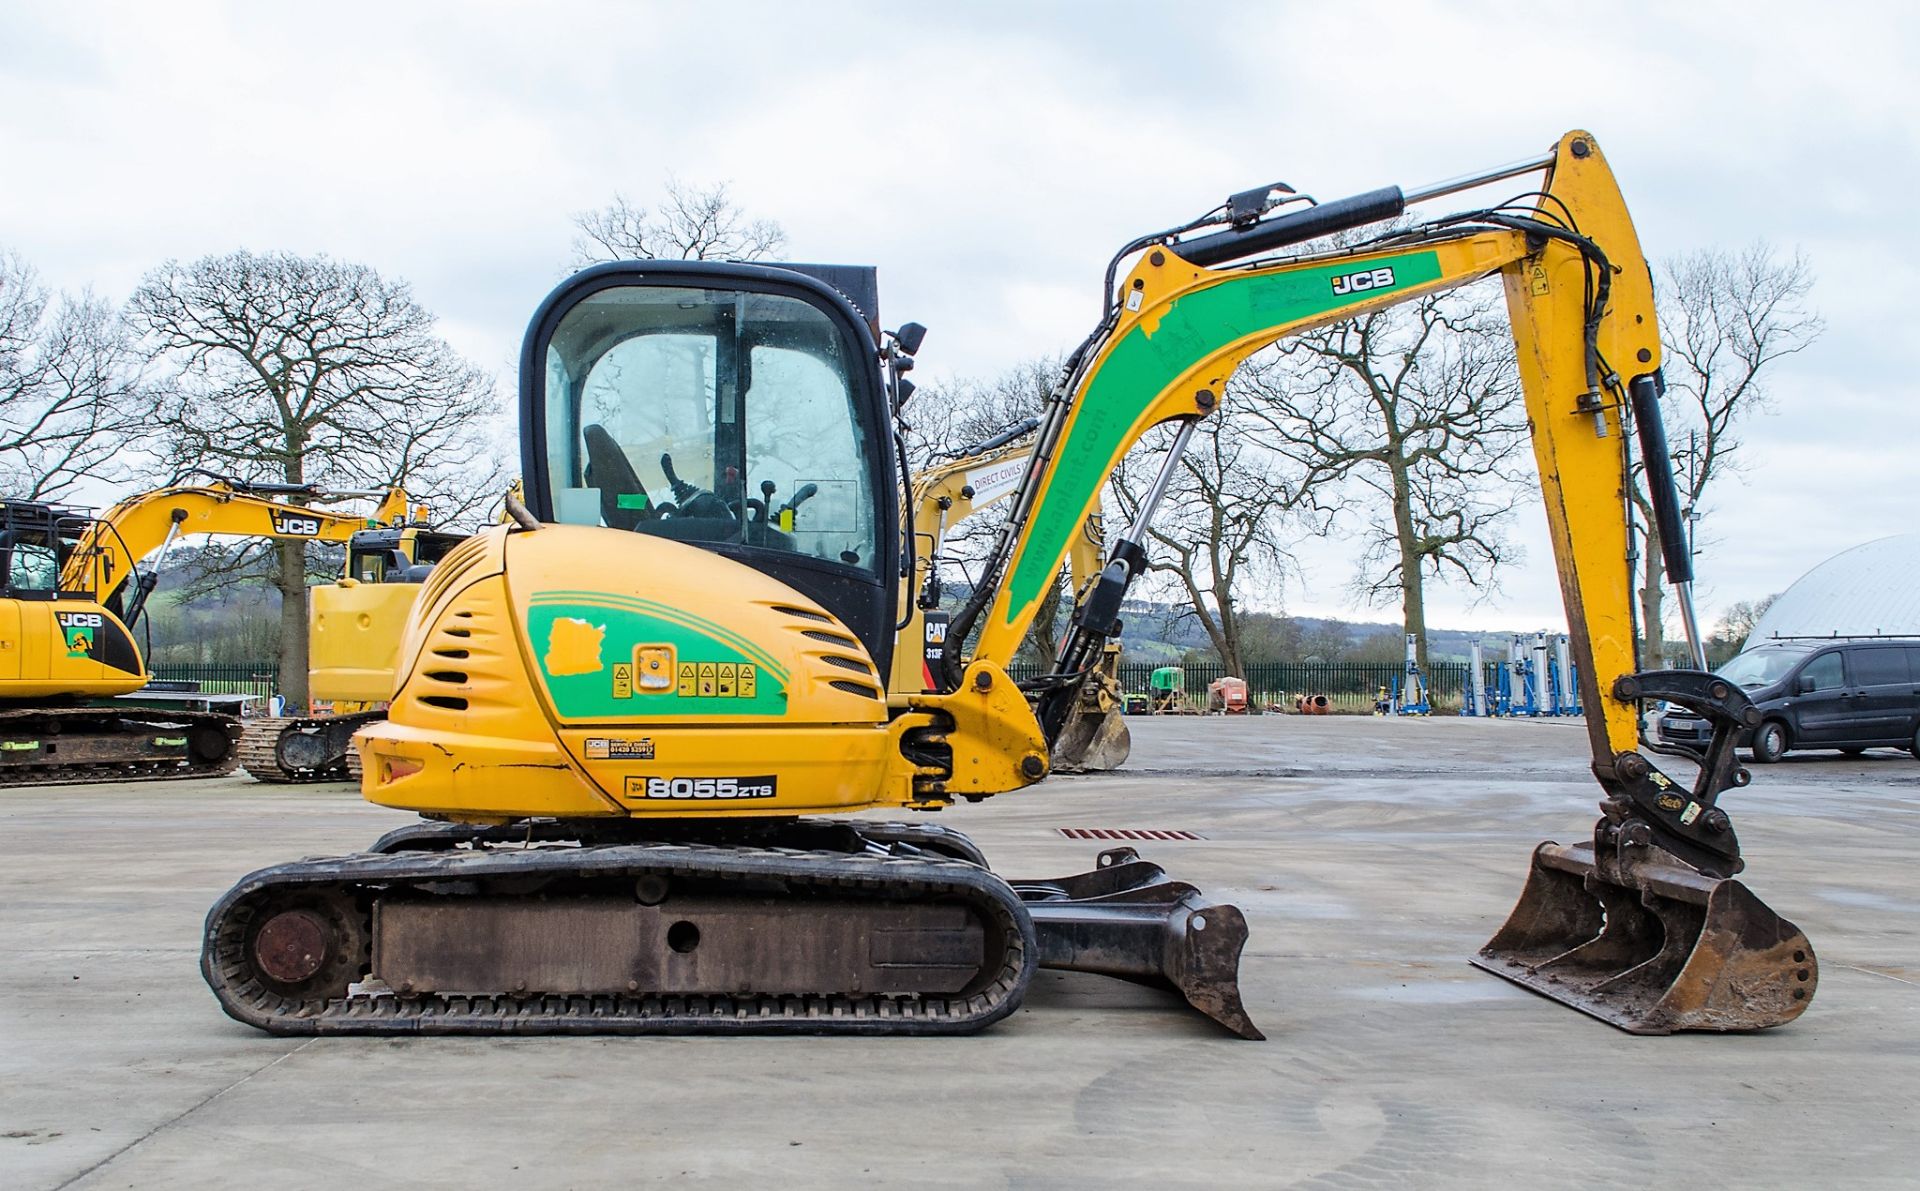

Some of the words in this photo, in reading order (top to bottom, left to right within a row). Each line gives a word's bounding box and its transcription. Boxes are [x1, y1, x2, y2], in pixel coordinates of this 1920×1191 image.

[1332, 268, 1394, 295] JCB
[974, 472, 999, 490] DIRECT
[1000, 463, 1021, 480] CIVILS
[1025, 408, 1108, 579] www.aplant.com
[275, 518, 318, 535] JCB
[59, 613, 103, 627] JCB
[925, 622, 948, 643] CAT
[926, 647, 943, 659] 313F
